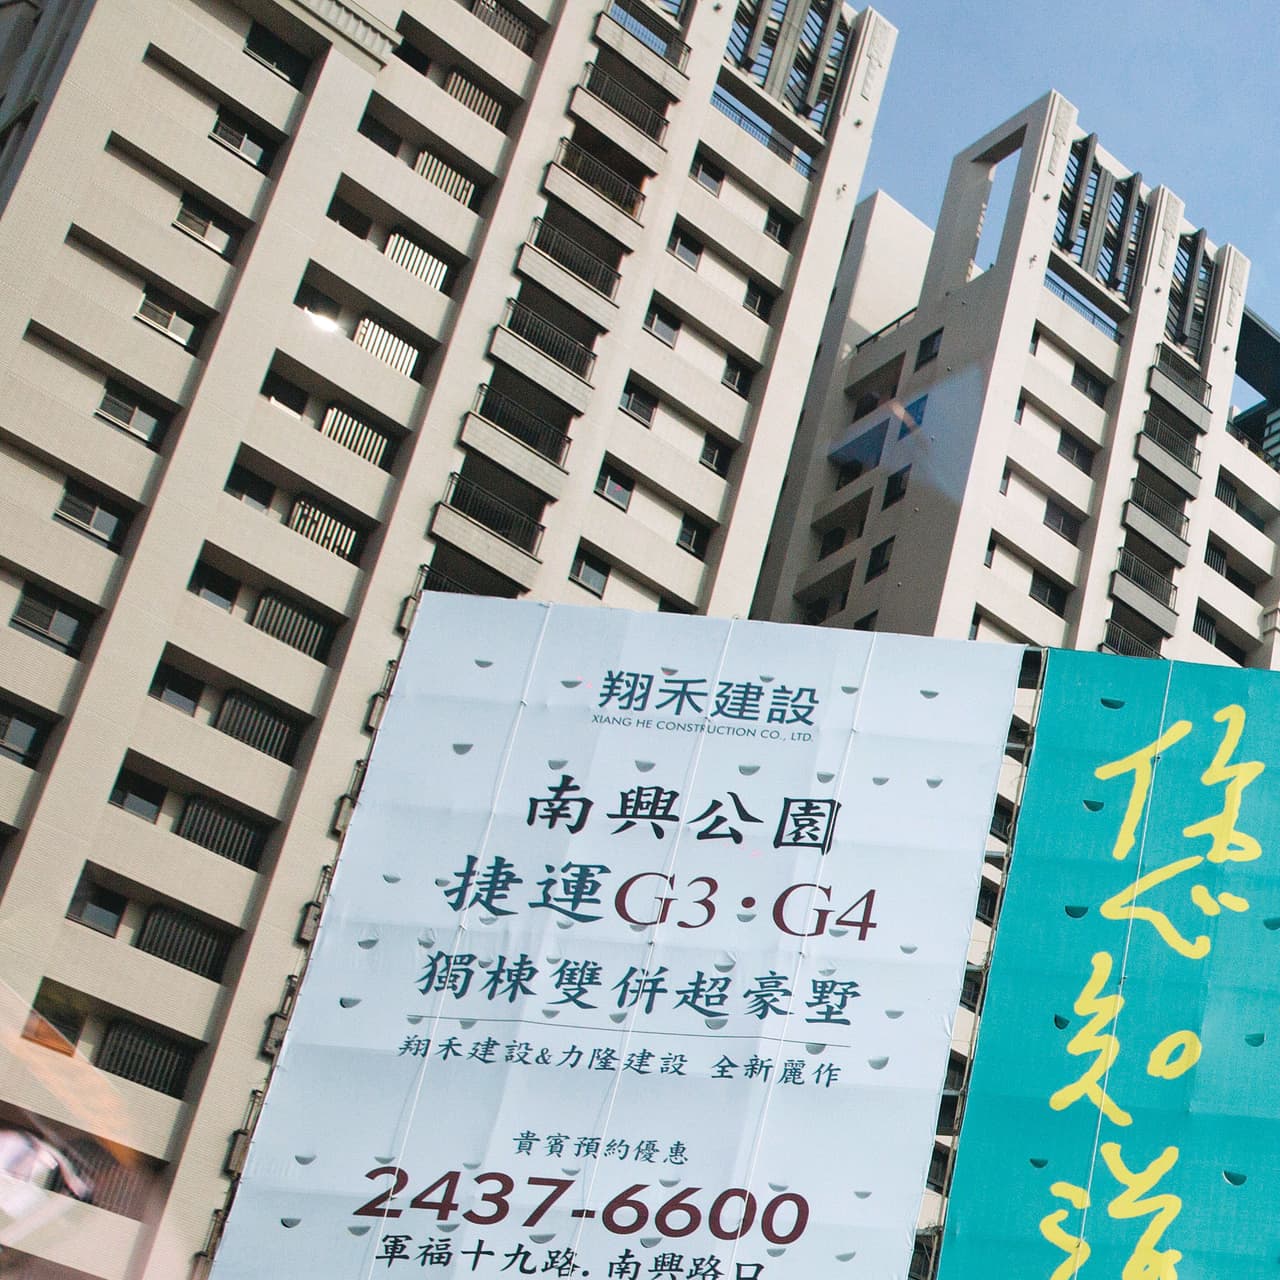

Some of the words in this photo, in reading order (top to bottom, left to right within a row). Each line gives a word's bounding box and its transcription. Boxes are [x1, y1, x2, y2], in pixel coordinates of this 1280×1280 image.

[598, 670, 819, 727] 翔禾建設
[592, 714, 632, 728] XIANG
[636, 719, 653, 729] HE
[656, 720, 757, 738] CONSTRUCTION
[526, 774, 842, 856] 南興公園
[709, 1056, 842, 1090] 全新麗作
[512, 1130, 689, 1166] 貴賓預約優惠
[353, 1166, 810, 1244] 2437-6600
